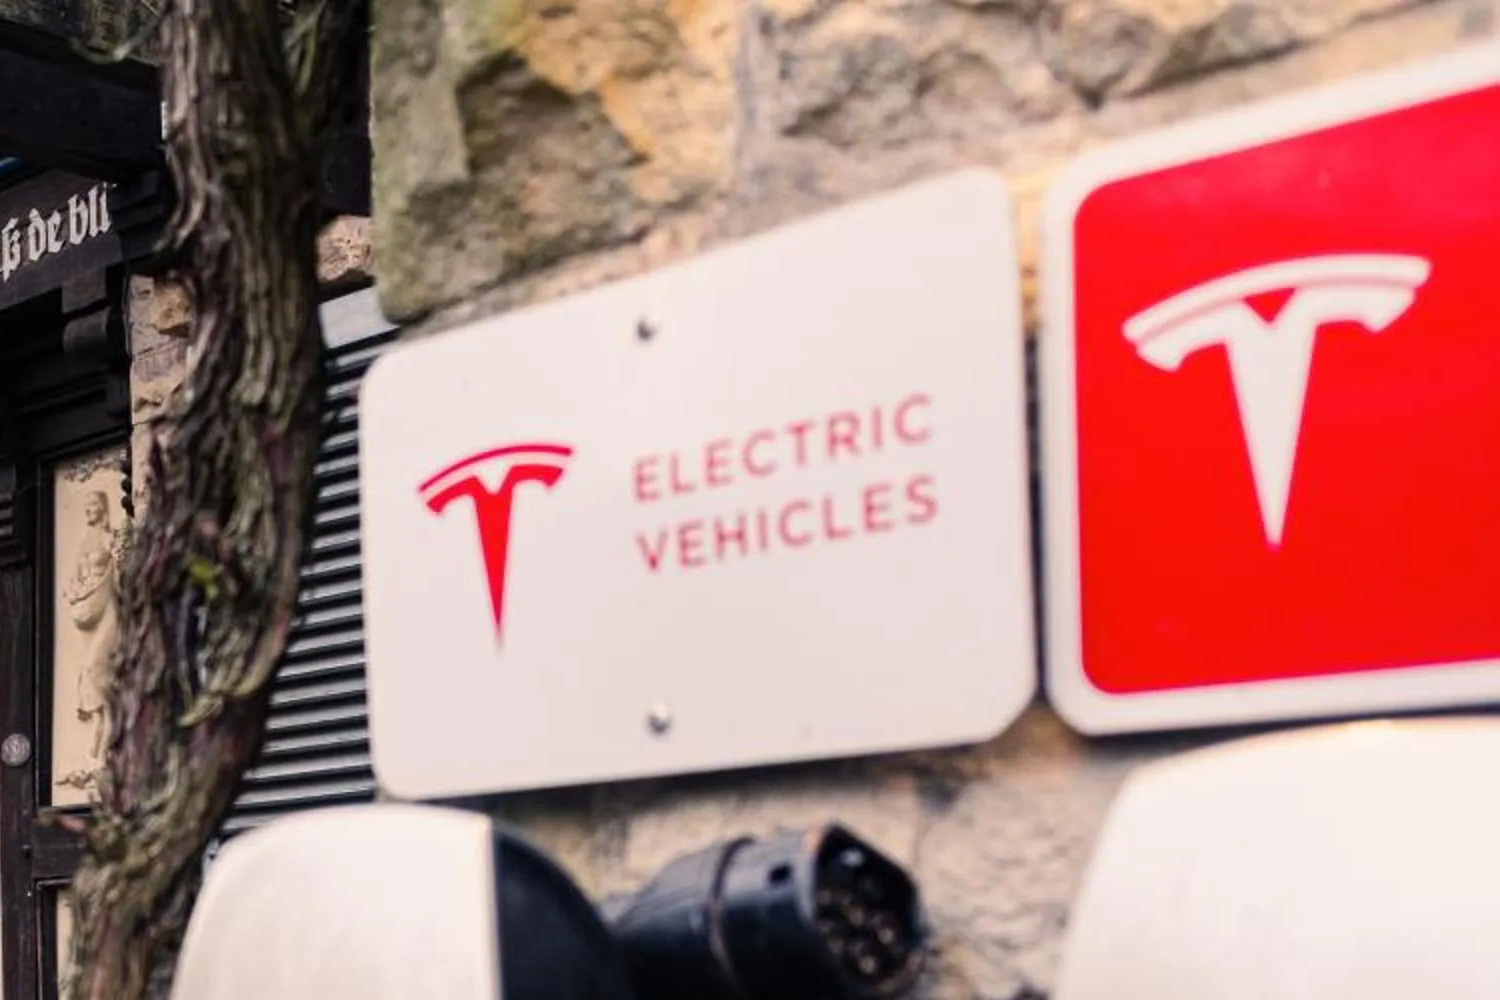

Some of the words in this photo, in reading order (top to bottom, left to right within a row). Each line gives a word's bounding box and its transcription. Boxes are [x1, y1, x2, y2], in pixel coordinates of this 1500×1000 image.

[27, 207, 68, 262] de
[634, 393, 933, 504] ELECTRIC
[635, 474, 939, 573] VEHICLES
